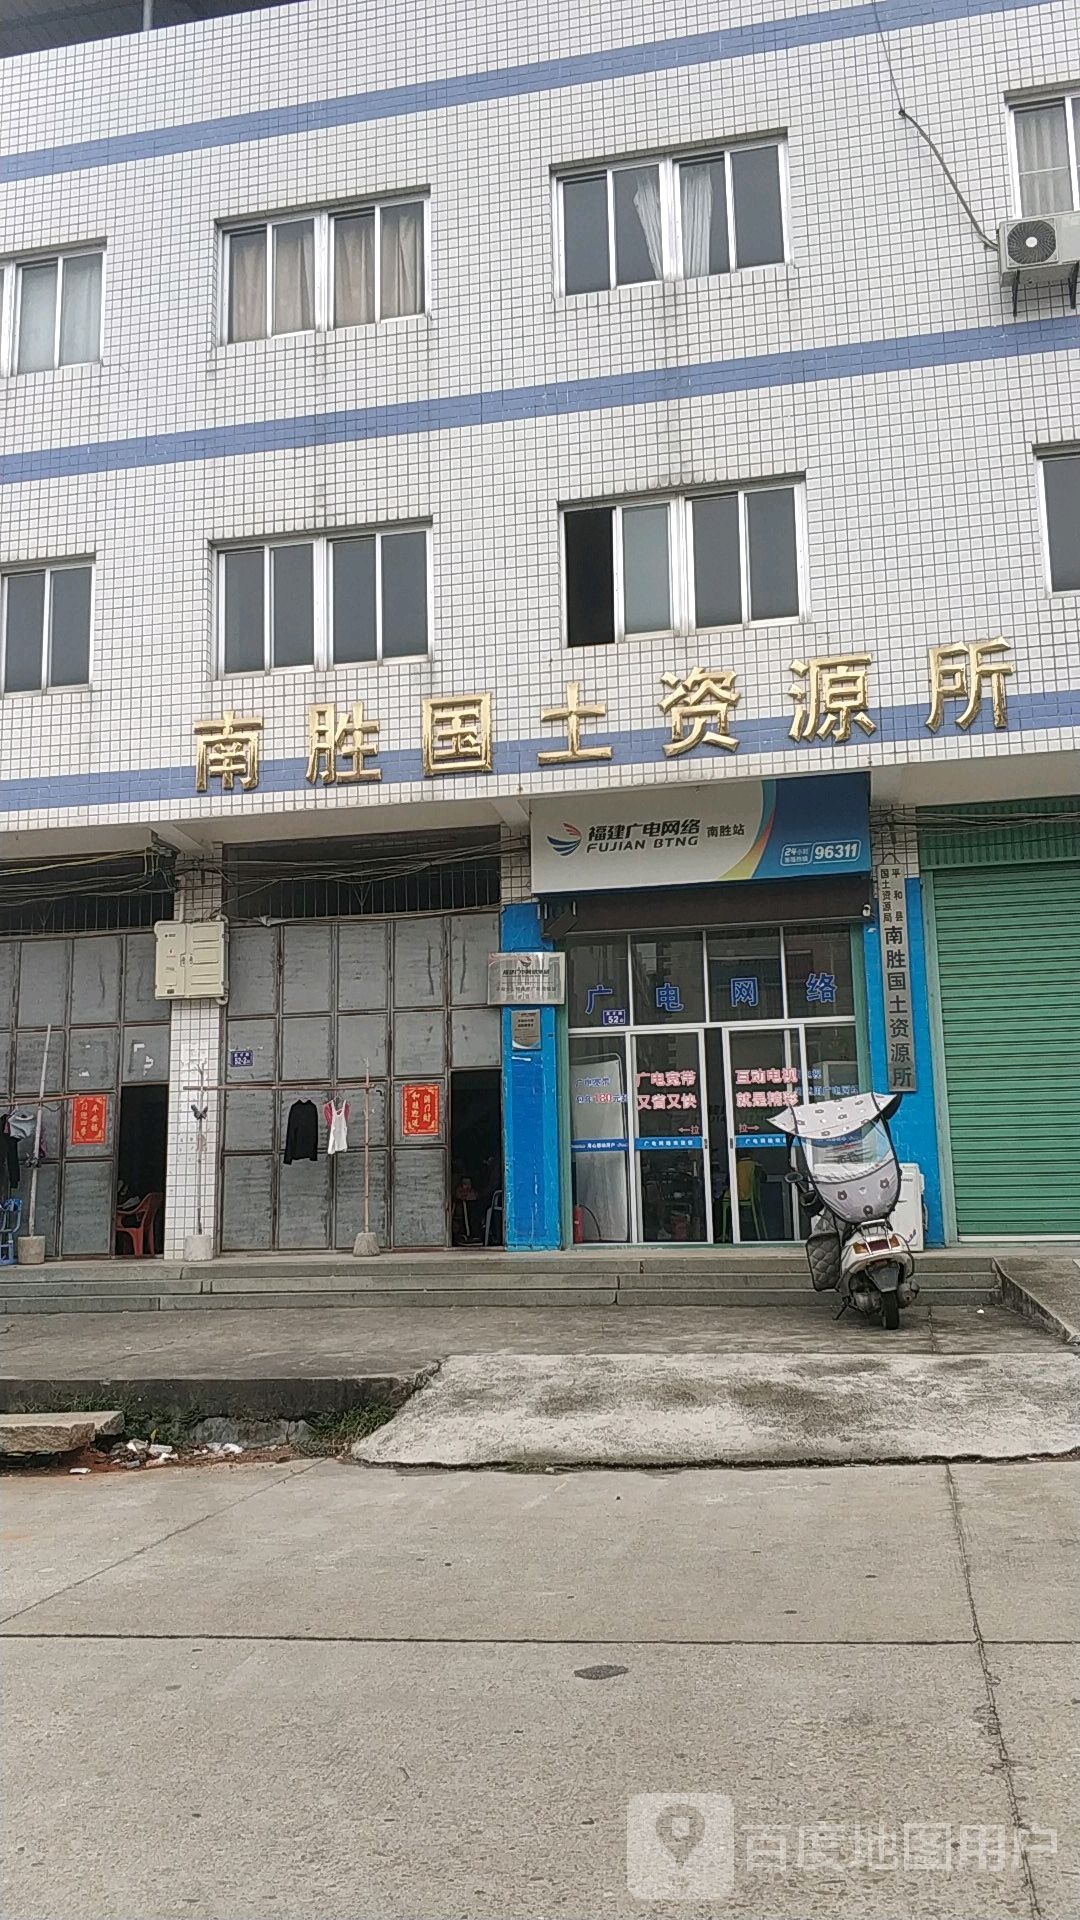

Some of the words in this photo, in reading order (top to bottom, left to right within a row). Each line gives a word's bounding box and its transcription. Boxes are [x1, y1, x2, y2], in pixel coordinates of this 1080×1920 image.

[193, 635, 1015, 792] 南胜国土资源所
[588, 818, 701, 841] 福建广电网络
[706, 824, 745, 838] 南胜站
[586, 840, 646, 854] FUJIAN
[653, 836, 700, 849] BTNG
[814, 843, 858, 860] 96311
[880, 868, 892, 923] 国土资源局
[891, 868, 904, 922] 平和县
[585, 973, 838, 1015] 广电网络
[884, 925, 913, 1088] 南胜国土资源所
[636, 1070, 697, 1087] 广电宽带
[735, 1067, 798, 1085] 互动电视
[637, 1092, 697, 1110] 又省又快
[736, 1090, 799, 1107] 就是精彩
